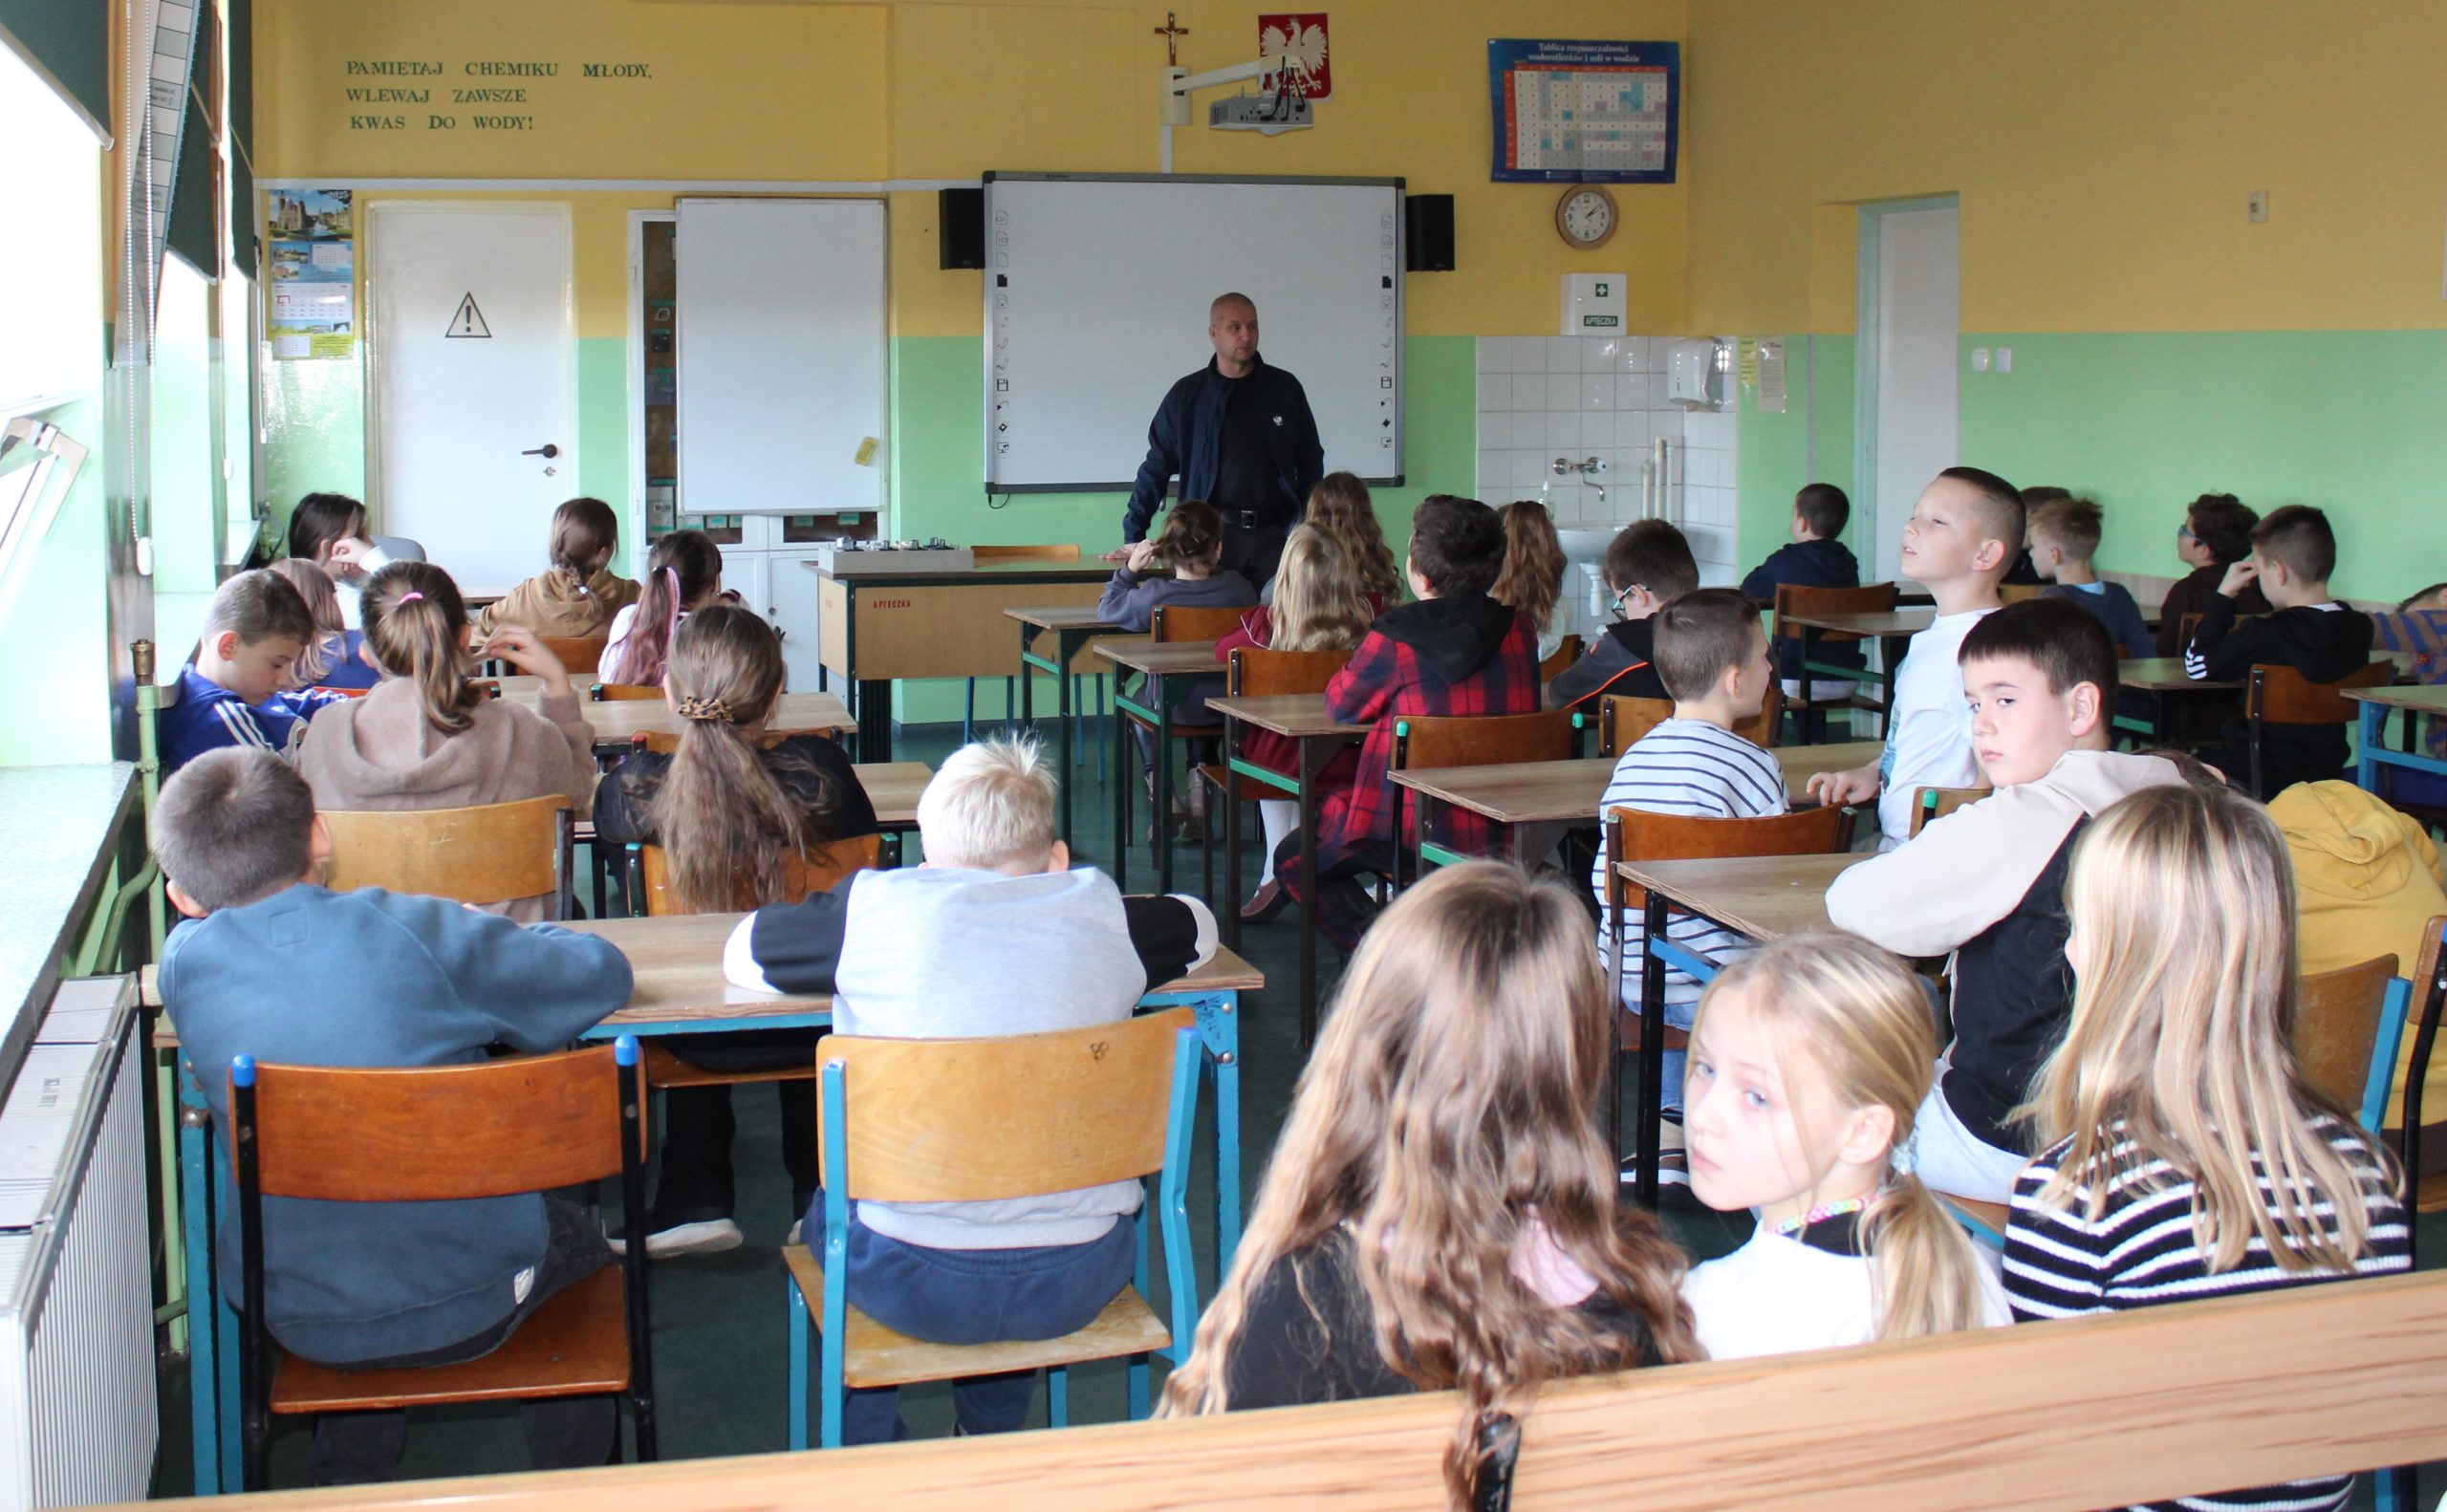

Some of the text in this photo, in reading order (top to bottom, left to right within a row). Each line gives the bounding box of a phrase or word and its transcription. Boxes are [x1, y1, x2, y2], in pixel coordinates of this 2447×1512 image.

[346, 60, 444, 76] PAMIĘTAJ
[465, 61, 559, 76] CHEMIKU
[346, 88, 527, 103] WLEWAJ ZAWSZE
[350, 115, 533, 130] KWAS DO WODY!
[873, 599, 911, 609] APTECZKA
